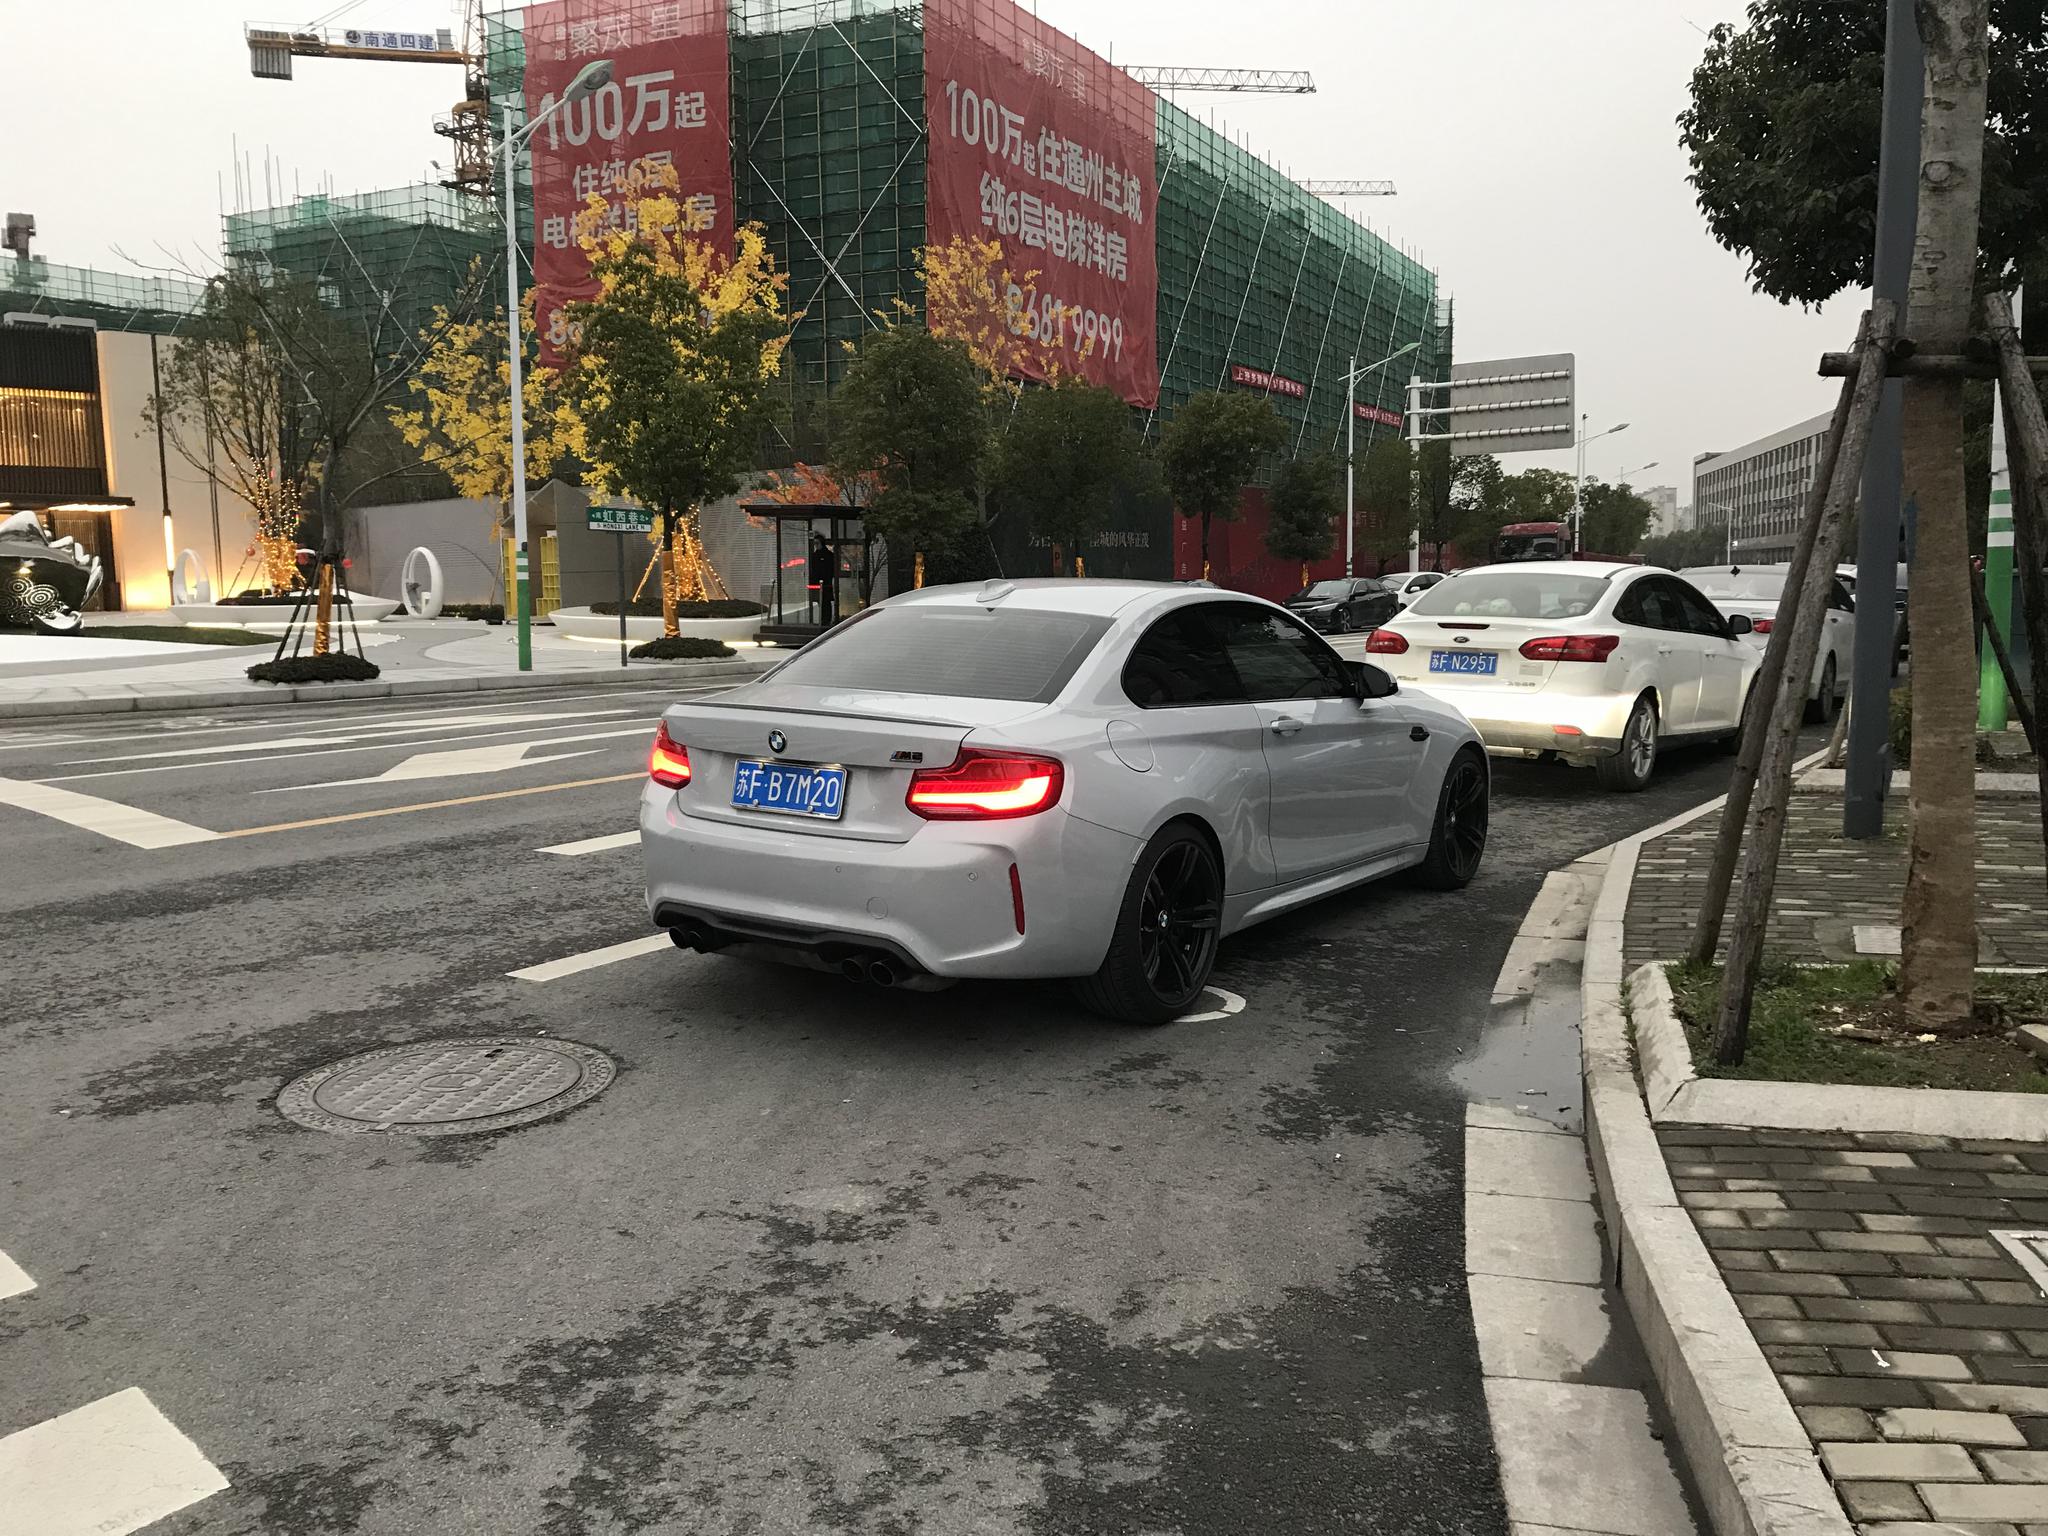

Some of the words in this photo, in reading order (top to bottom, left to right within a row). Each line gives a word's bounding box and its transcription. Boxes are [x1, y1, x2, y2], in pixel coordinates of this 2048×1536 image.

[363, 32, 434, 50] 南通四建
[979, 170, 1128, 282] 纯6层电梯洋房
[602, 509, 639, 524] 虹西巷
[736, 768, 840, 808] 苏F·B7M20
